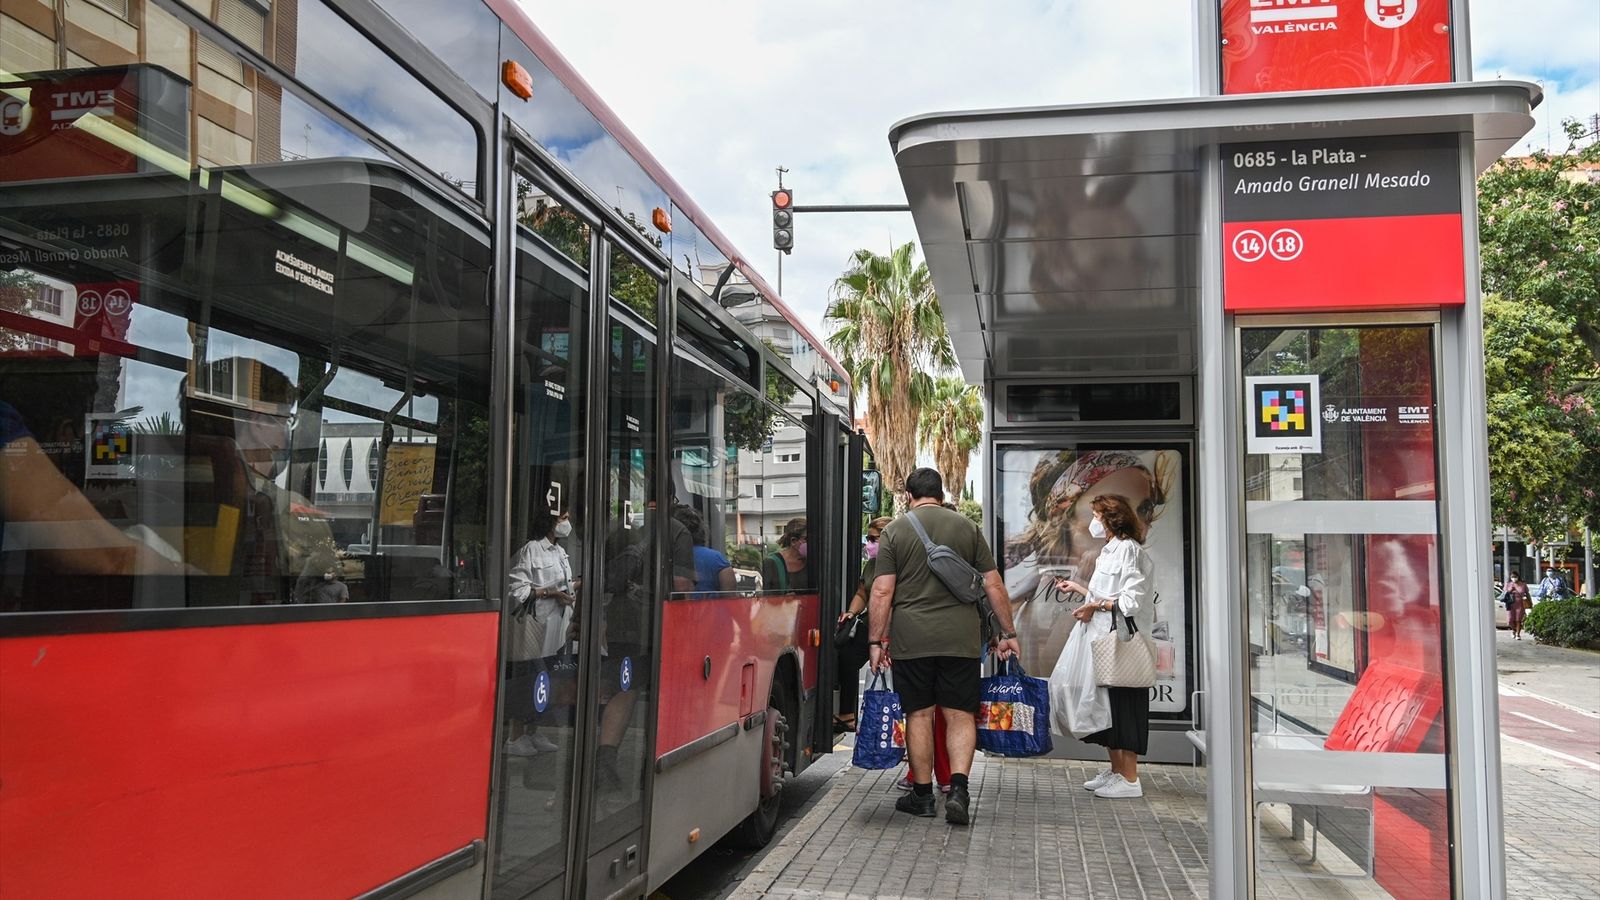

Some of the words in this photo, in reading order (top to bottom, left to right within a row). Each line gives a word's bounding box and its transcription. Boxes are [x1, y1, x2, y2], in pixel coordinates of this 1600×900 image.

[1251, 22, 1337, 35] VALÈNCIA
[1233, 151, 1276, 168] 0685
[1292, 150, 1307, 166] la
[1312, 148, 1355, 164] Plata
[1234, 176, 1293, 194] Amado
[1298, 173, 1359, 191] Granell
[1364, 170, 1431, 189] Mesado
[1240, 237, 1260, 254] 14
[1276, 236, 1296, 252] 18
[1352, 414, 1387, 422] VALÈNCIA
